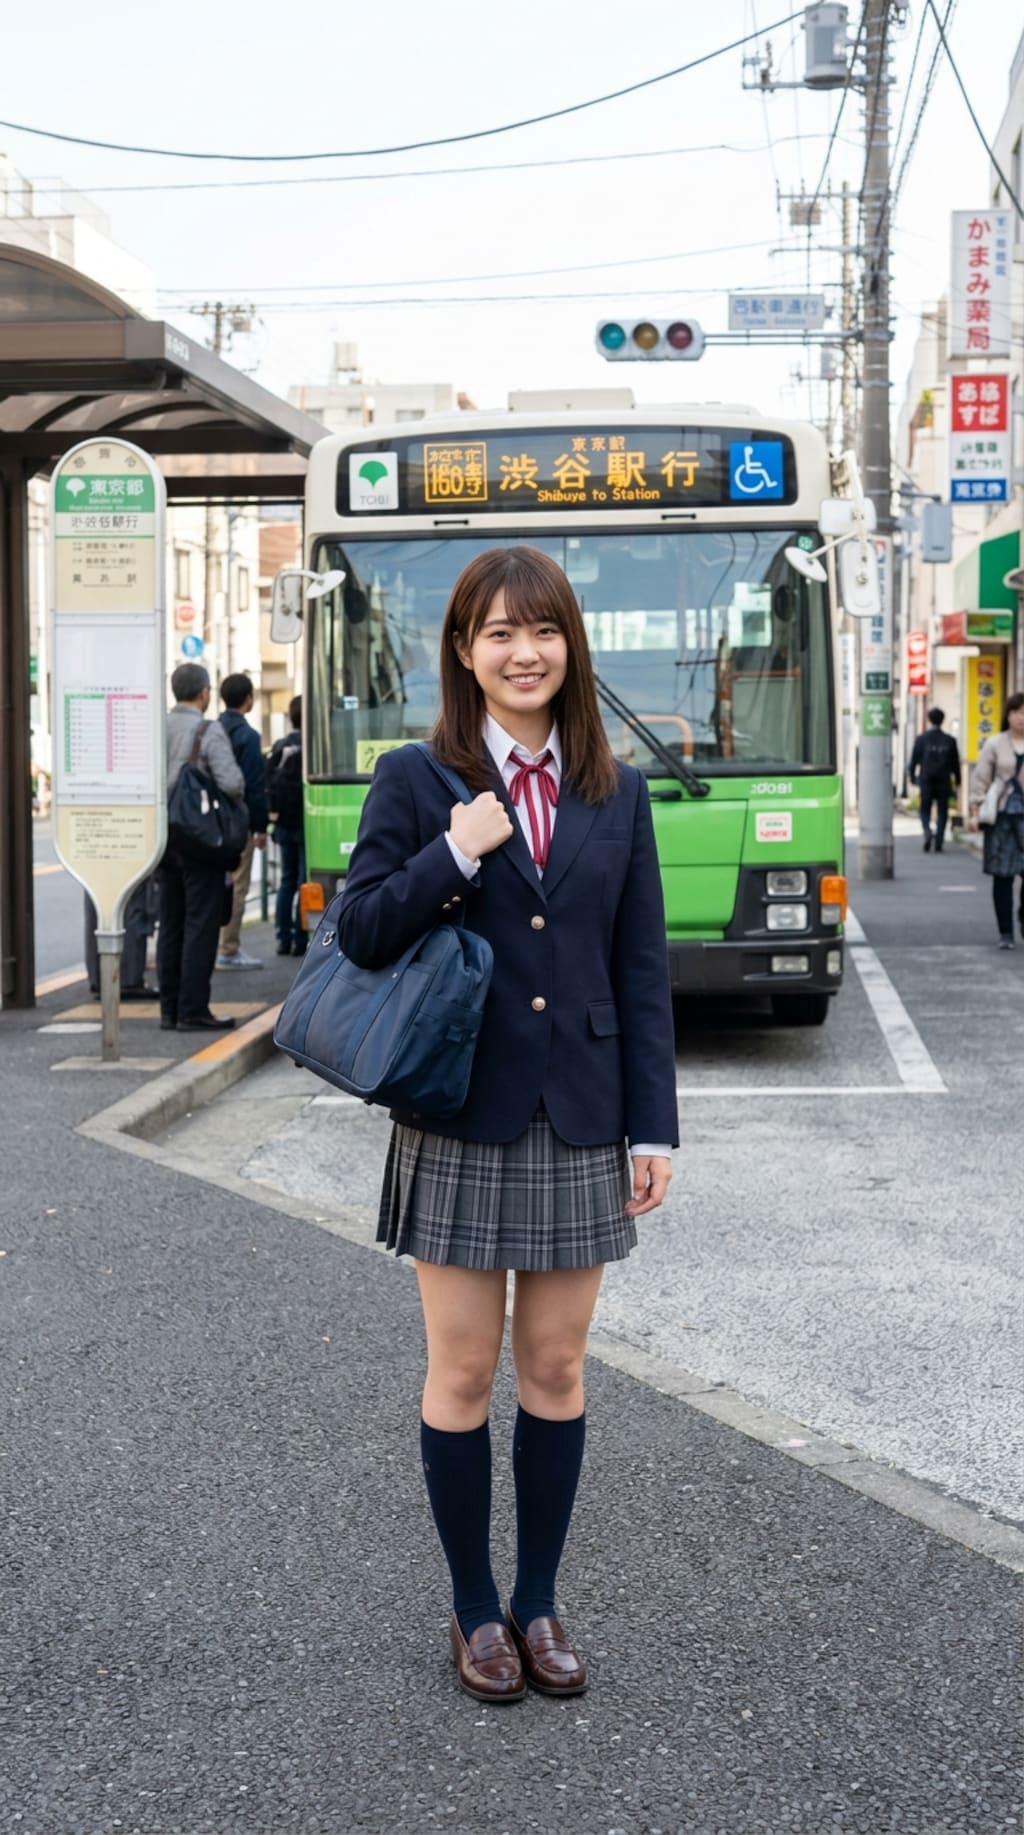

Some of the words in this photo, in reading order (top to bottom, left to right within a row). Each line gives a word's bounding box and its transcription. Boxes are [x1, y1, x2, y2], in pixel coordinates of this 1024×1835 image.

[499, 451, 700, 491] 渋谷駅行
[592, 490, 607, 501] to
[612, 487, 660, 500] Station
